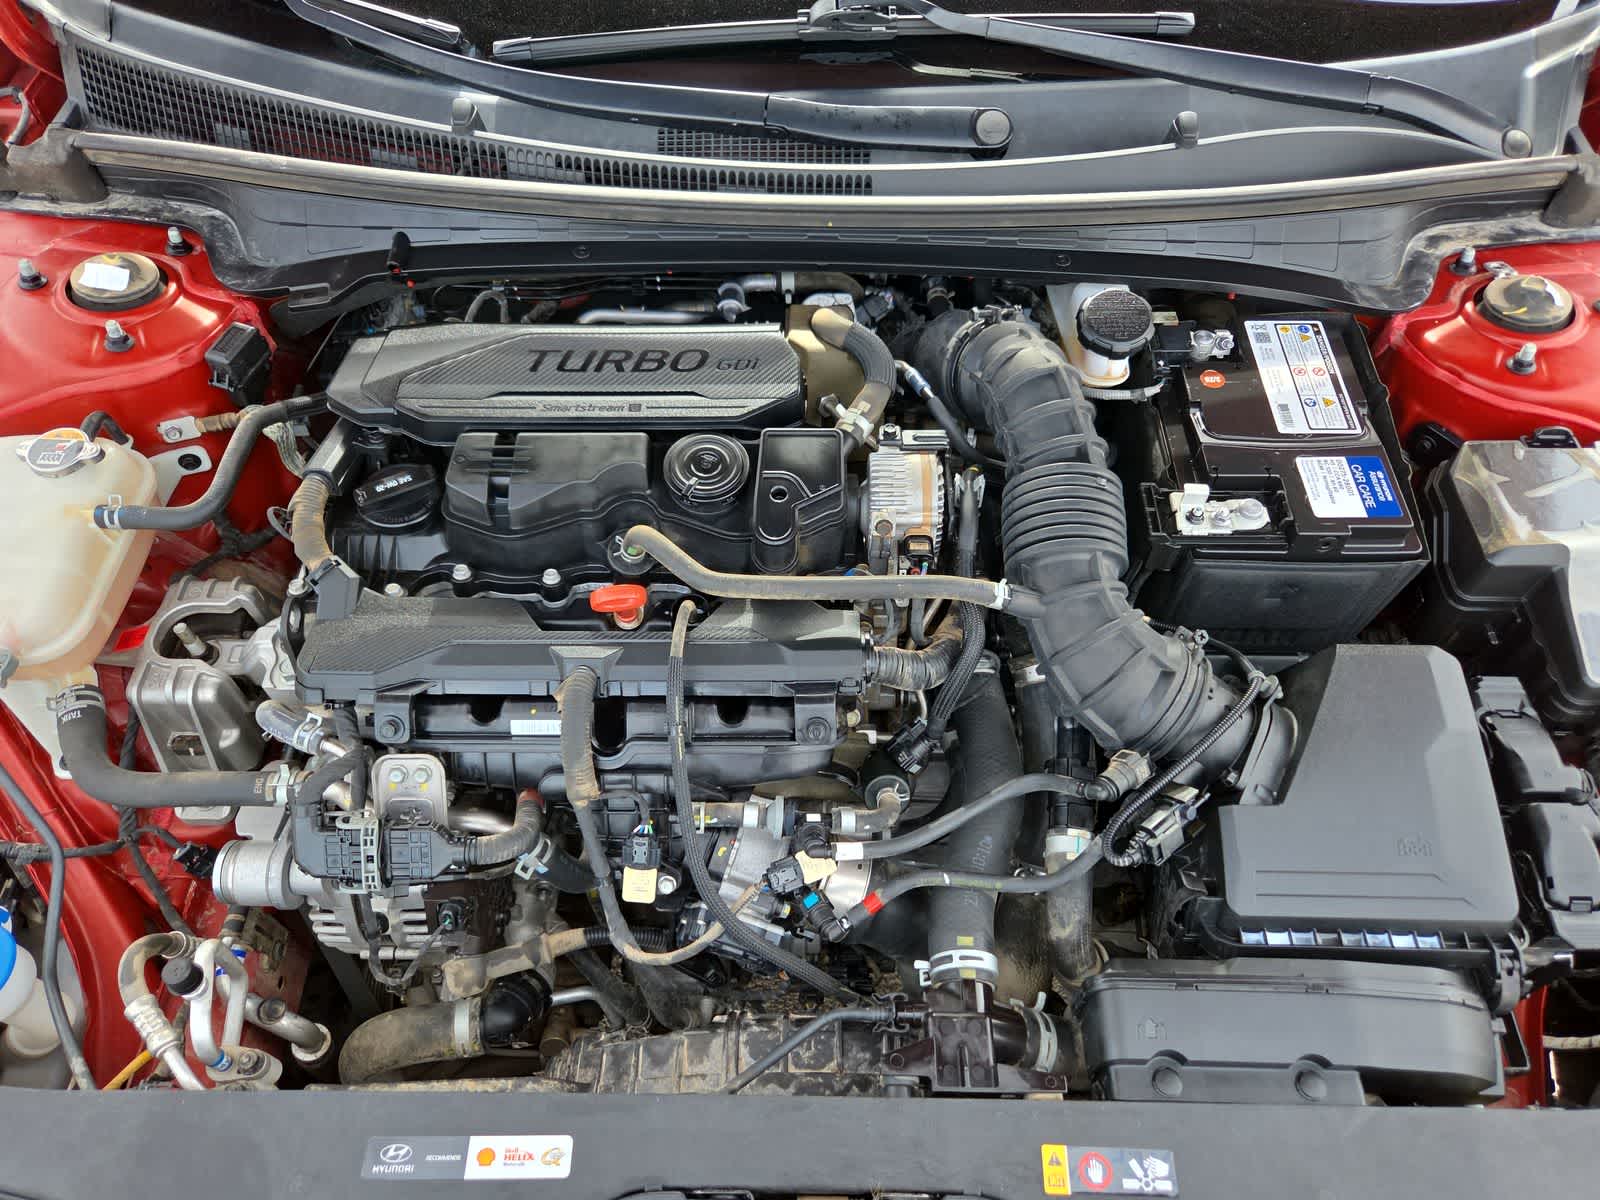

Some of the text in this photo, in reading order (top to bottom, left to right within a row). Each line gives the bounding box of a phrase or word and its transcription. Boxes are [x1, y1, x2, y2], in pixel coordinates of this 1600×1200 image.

[527, 349, 710, 373] TURBO
[540, 403, 626, 414] Smartstream
[1351, 464, 1376, 509] CAR CARE
[1368, 471, 1386, 502] Assurance
[503, 1152, 535, 1161] HELIX
[371, 1164, 415, 1174] HYUNDAI
